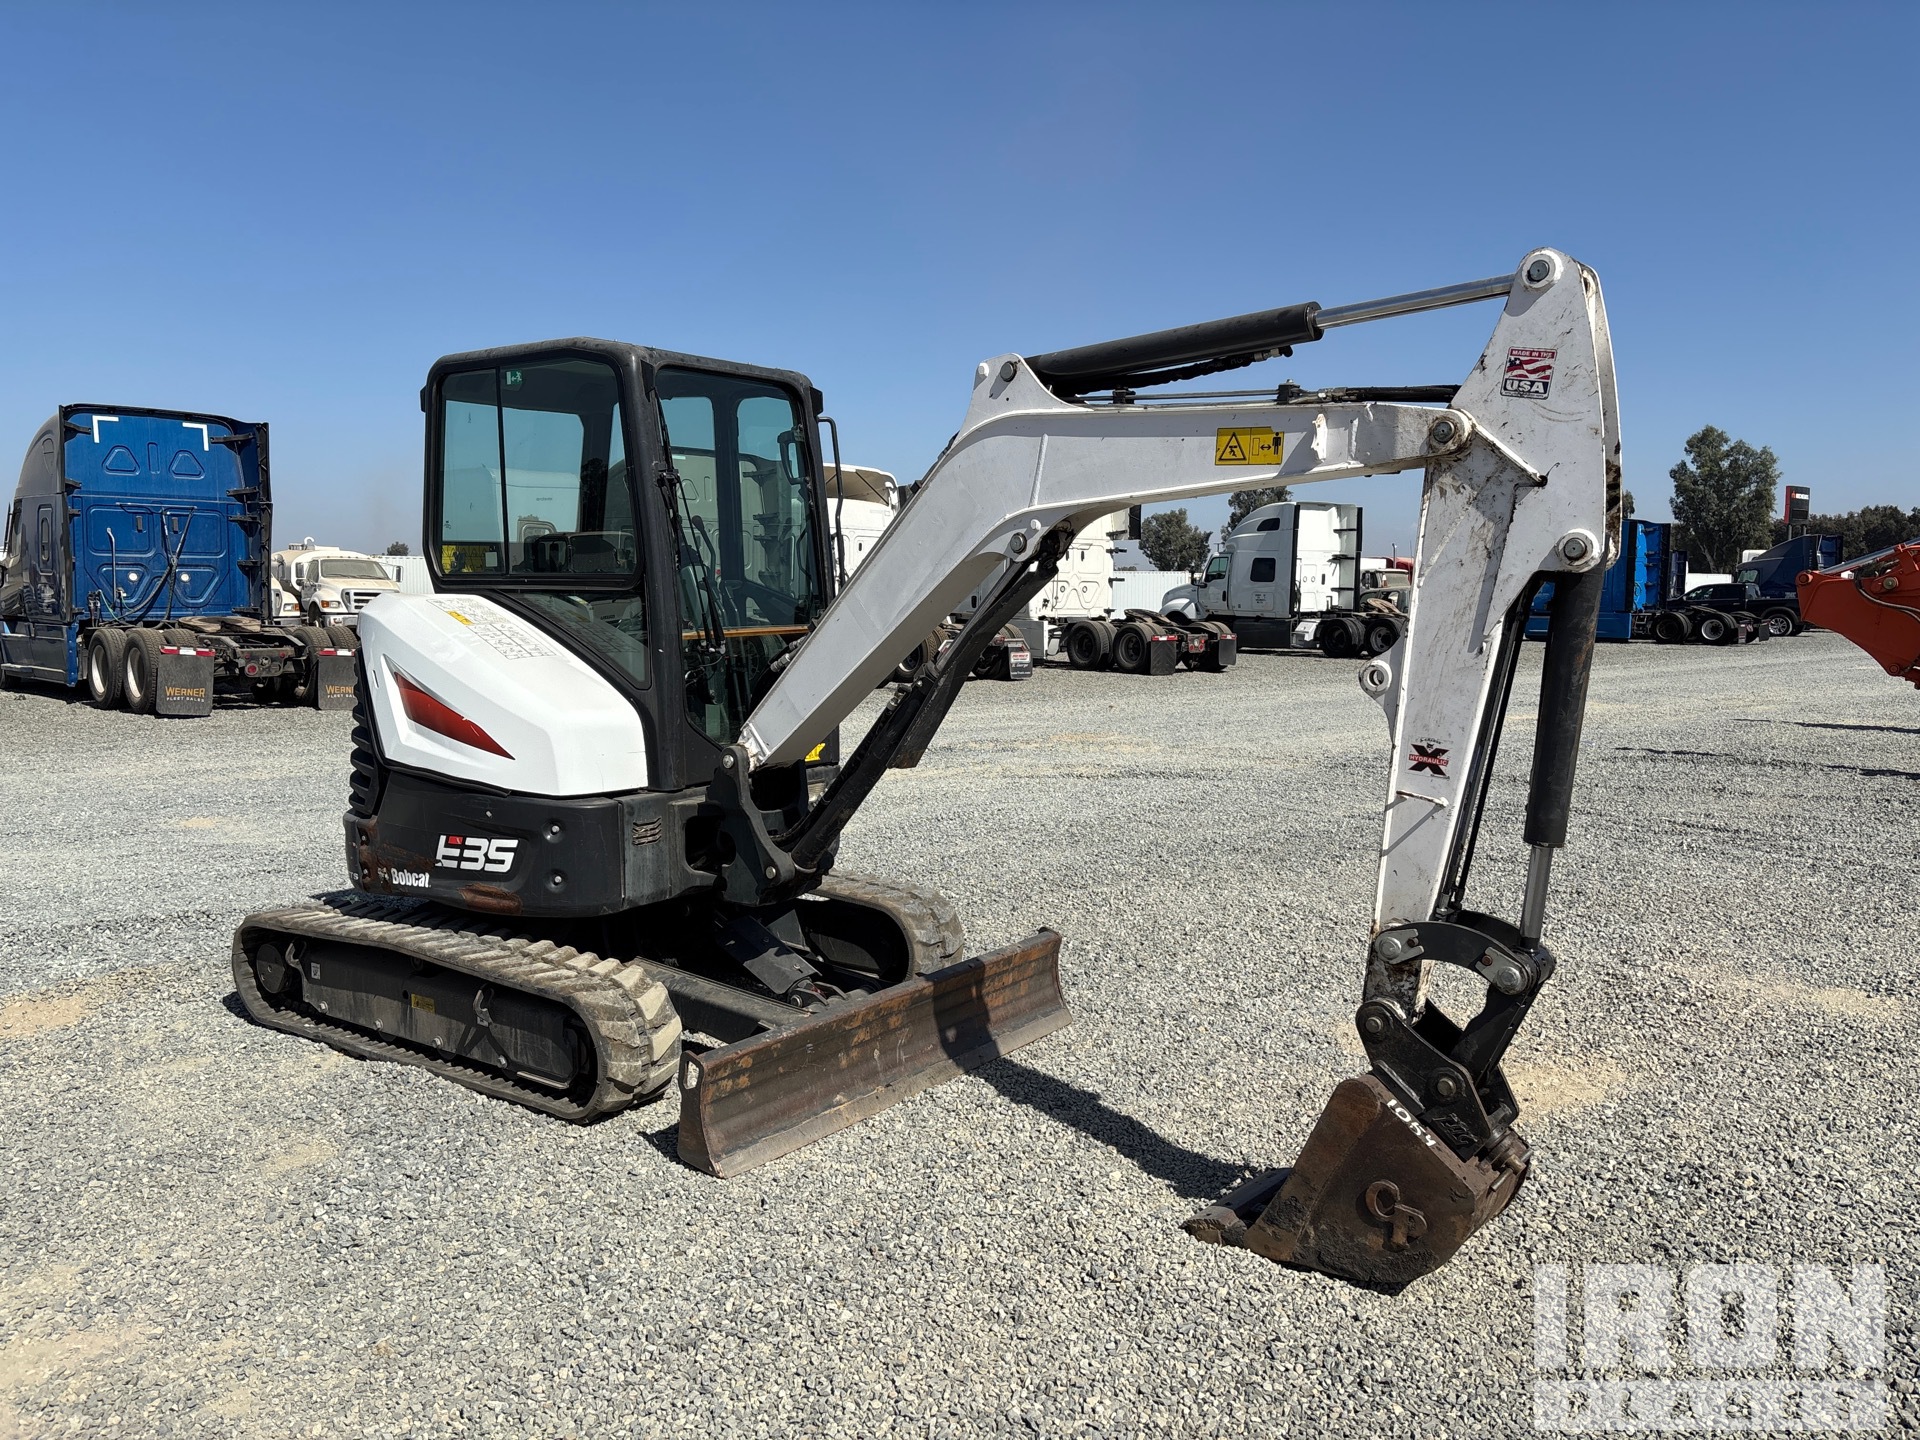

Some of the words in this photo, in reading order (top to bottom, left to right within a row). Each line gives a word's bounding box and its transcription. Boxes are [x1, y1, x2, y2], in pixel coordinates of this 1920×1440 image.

[1505, 380, 1545, 394] USA
[165, 686, 206, 698] WERNER
[325, 684, 354, 695] WERN
[1410, 755, 1448, 766] HYDRAULIC
[435, 834, 519, 873] E35
[390, 867, 430, 888] Bobcat
